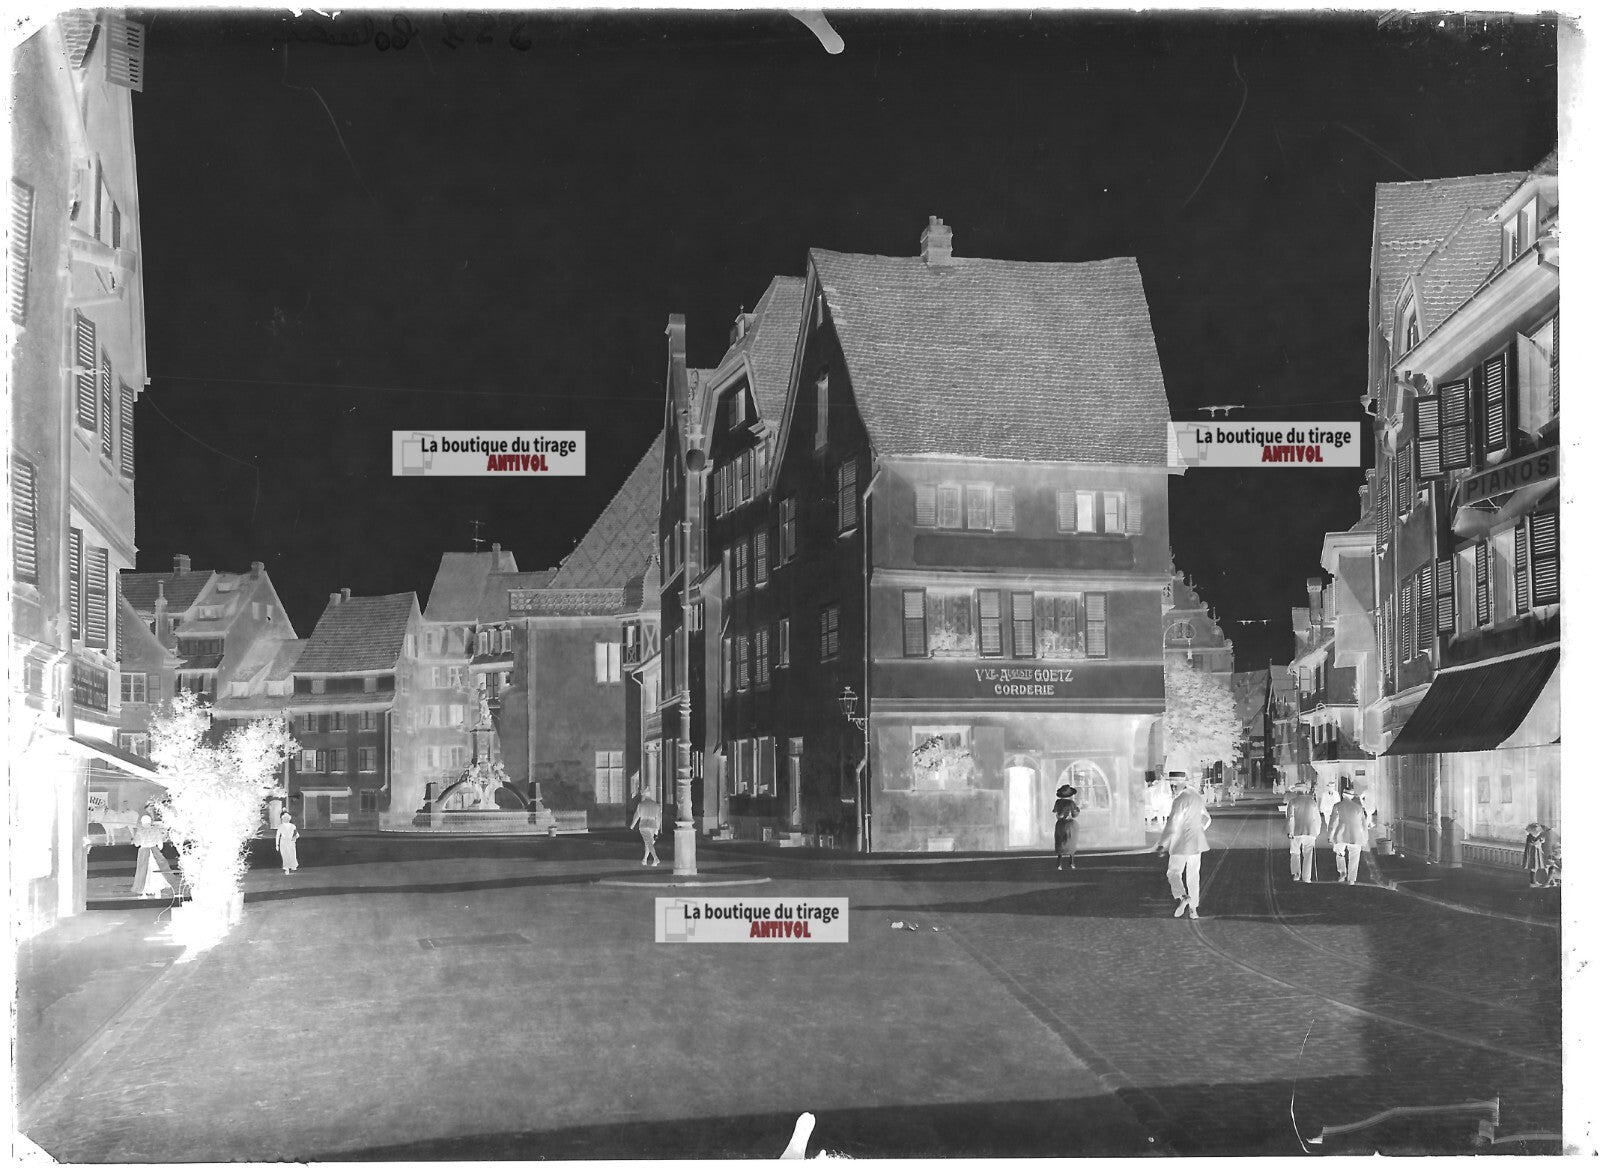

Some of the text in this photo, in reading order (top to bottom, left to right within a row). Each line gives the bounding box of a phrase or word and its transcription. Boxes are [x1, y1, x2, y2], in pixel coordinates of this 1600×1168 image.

[1467, 455, 1550, 500] PIANOS
[1034, 668, 1074, 682] GOETZ
[994, 683, 1055, 696] CORDERIE
